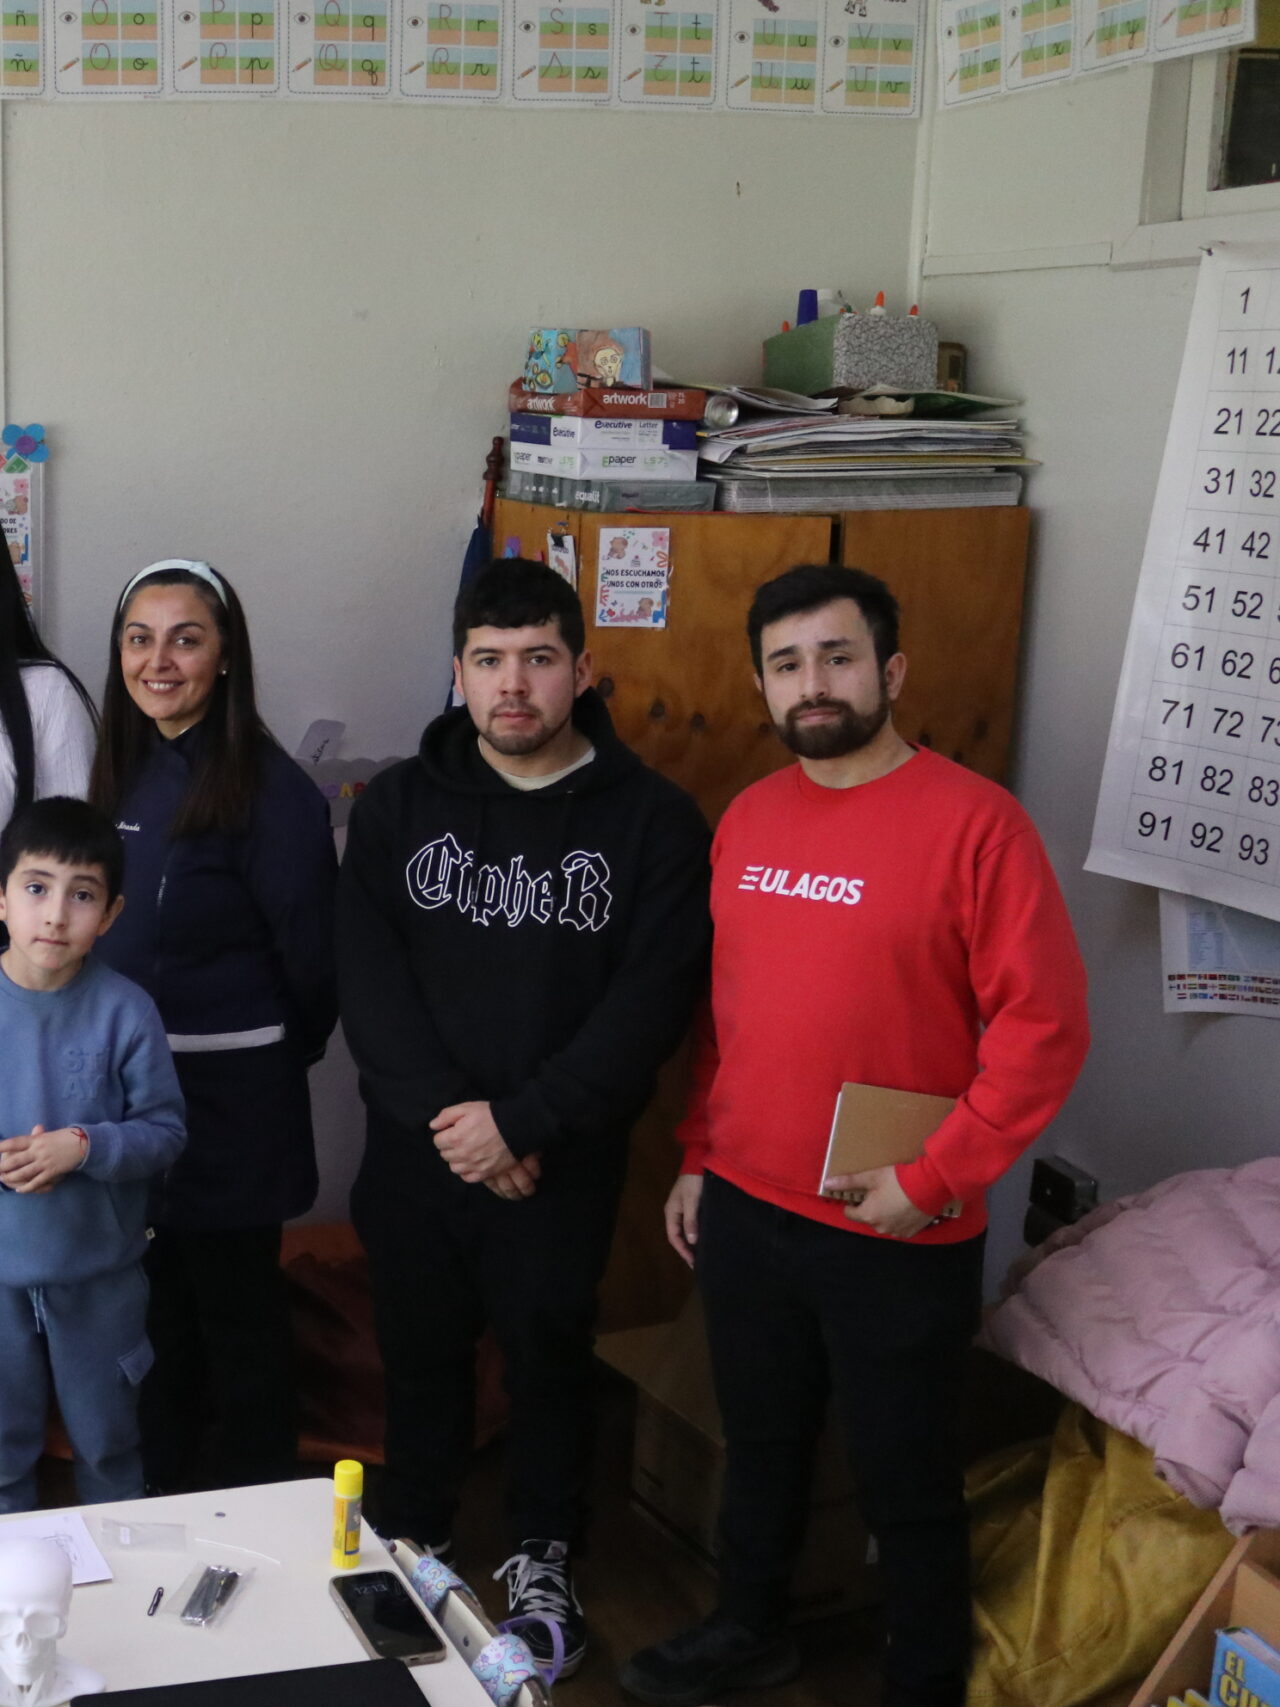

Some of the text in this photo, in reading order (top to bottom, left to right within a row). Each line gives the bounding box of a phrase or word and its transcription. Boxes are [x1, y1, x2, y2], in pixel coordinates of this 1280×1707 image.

[15, 10, 27, 27] ñ
[90, 0, 145, 26] O o
[250, 12, 264, 39] p
[323, 0, 375, 41] Q q
[438, 4, 487, 32] R r
[549, 7, 598, 36] S s
[654, 11, 702, 40] T t
[762, 19, 808, 48] U u
[857, 23, 902, 50] V v
[9, 52, 33, 72] ñ
[132, 57, 150, 71] o
[244, 56, 270, 84] p
[360, 59, 379, 87] q
[687, 55, 704, 83] t
[791, 76, 810, 91] u
[1239, 287, 1251, 314] 1
[1227, 346, 1280, 375] 11 1
[602, 392, 648, 405] artwork
[1213, 407, 1280, 437] 21 22
[1204, 467, 1276, 498] 31 32
[1193, 527, 1271, 559] 41 42
[606, 569, 666, 577] NOS ESCUCHAMOS
[1181, 584, 1264, 619] 51 52
[1170, 642, 1206, 672] 61
[1221, 649, 1254, 679] 62
[1161, 699, 1195, 729] 71
[1213, 707, 1244, 738] 72
[1148, 756, 1280, 807] 81 82 83
[1137, 812, 1270, 866] 91 92 93
[758, 866, 865, 905] ULAGOS
[1224, 1650, 1246, 1683] EL
